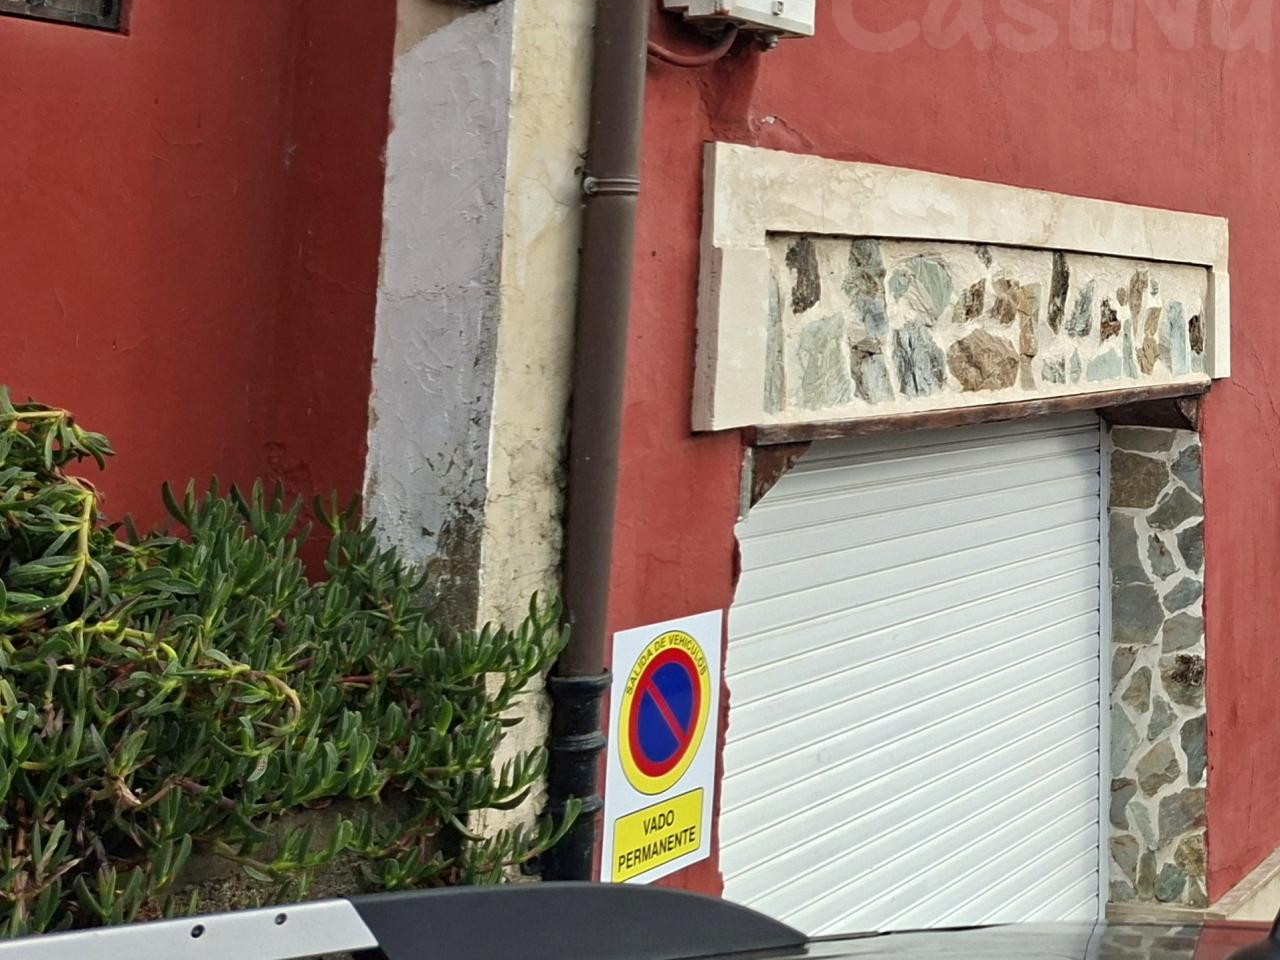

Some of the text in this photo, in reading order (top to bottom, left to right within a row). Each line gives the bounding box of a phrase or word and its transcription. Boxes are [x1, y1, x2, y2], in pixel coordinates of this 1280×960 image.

[626, 634, 707, 696] SALIDA DE VEHICULOS
[643, 809, 675, 836] VADO
[617, 825, 697, 873] PERMANENTE
